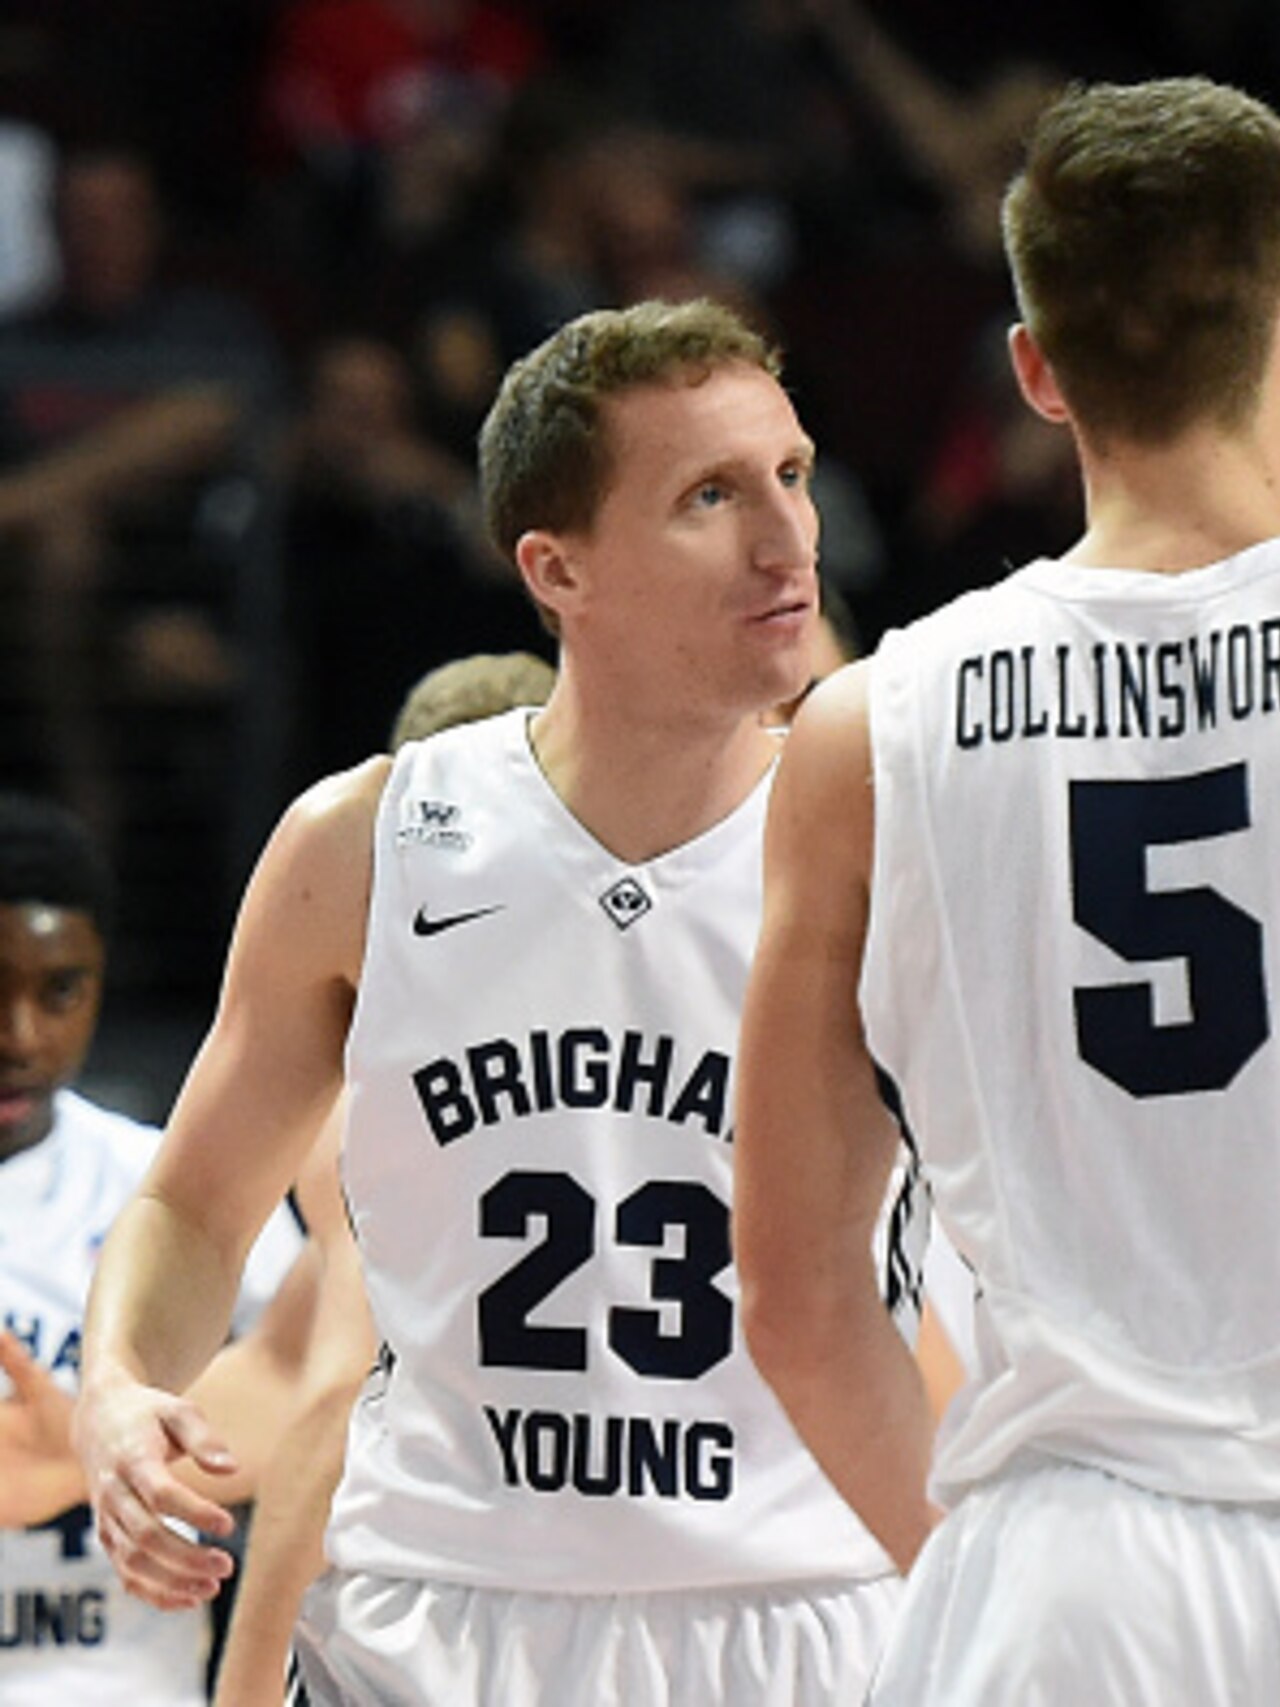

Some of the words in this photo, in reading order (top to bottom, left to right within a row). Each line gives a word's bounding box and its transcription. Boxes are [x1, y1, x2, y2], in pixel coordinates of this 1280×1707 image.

[1069, 761, 1271, 1100] 5
[412, 1027, 735, 1147] BRIGHA
[478, 1170, 734, 1380] 23
[483, 1406, 734, 1501] YOUNG
